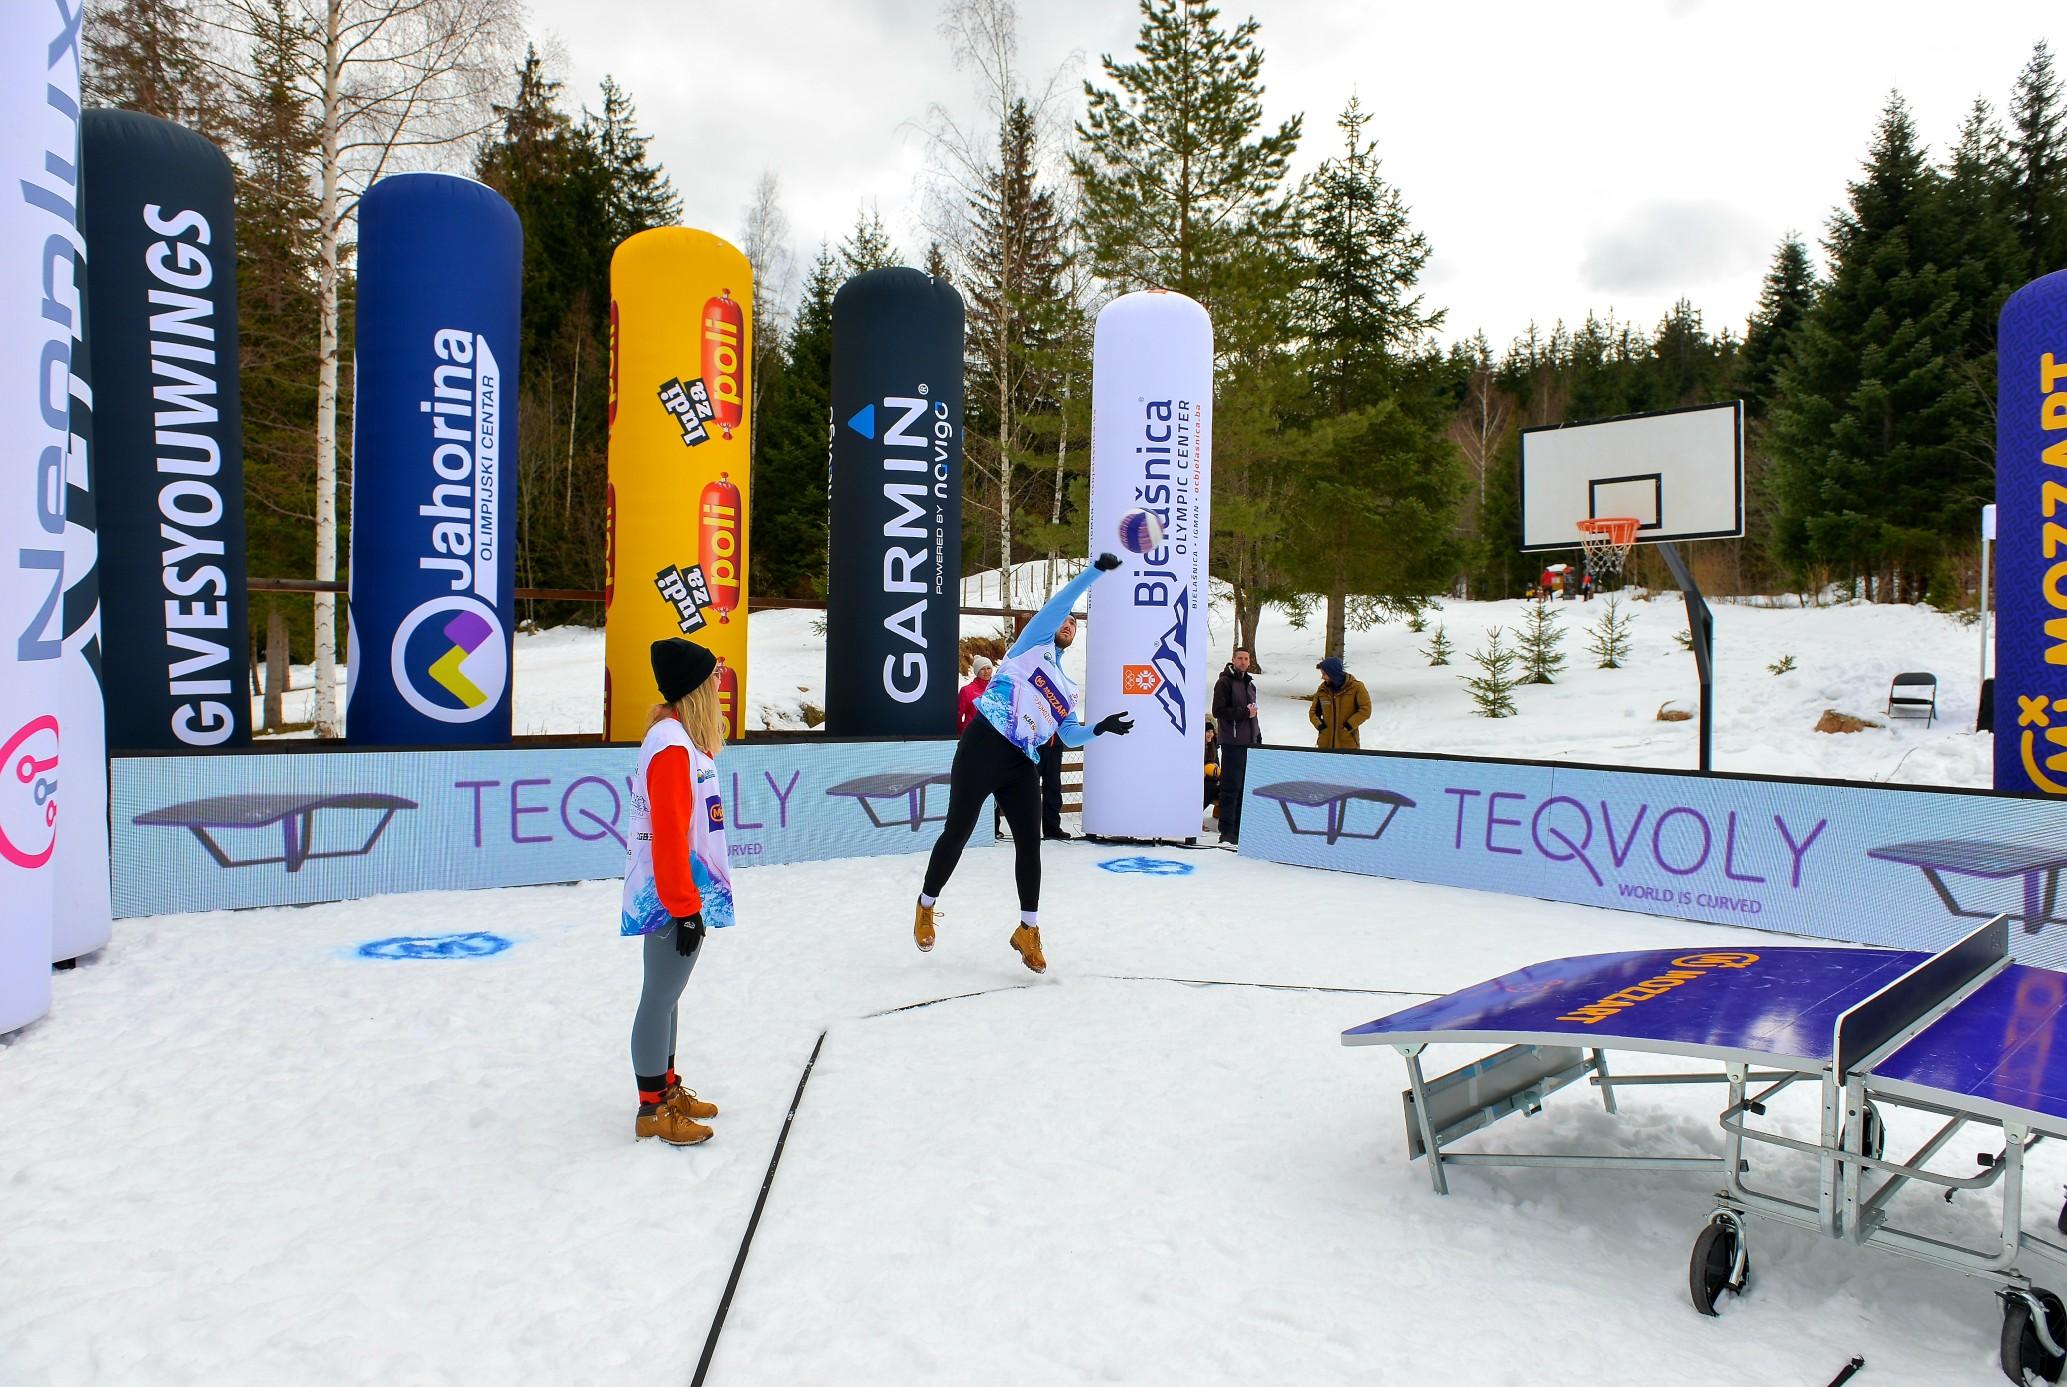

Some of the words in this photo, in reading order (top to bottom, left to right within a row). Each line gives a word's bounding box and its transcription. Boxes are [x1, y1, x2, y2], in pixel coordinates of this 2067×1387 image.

[690, 381, 712, 418] za
[705, 318, 742, 405] poli
[481, 375, 494, 449] CENTAR
[661, 383, 706, 444] ludi
[934, 401, 952, 498] navigo
[1177, 400, 1190, 471] CENTER
[419, 328, 473, 591] Jahorina
[480, 456, 494, 561] OLIMPIJSKI
[703, 504, 739, 588] poli
[937, 504, 944, 519] BY
[1176, 477, 1188, 555] OLYMPIC
[687, 568, 709, 605] za
[883, 396, 929, 704] GARMIN
[658, 570, 703, 631] ludi
[455, 770, 800, 849] TEQLY
[1444, 787, 1828, 888] TEQVOLY
[1618, 884, 1674, 902] WORLD
[1679, 891, 1691, 905] IS
[1696, 893, 1762, 914] CURVED
[1555, 969, 1708, 1024] MOZZART
